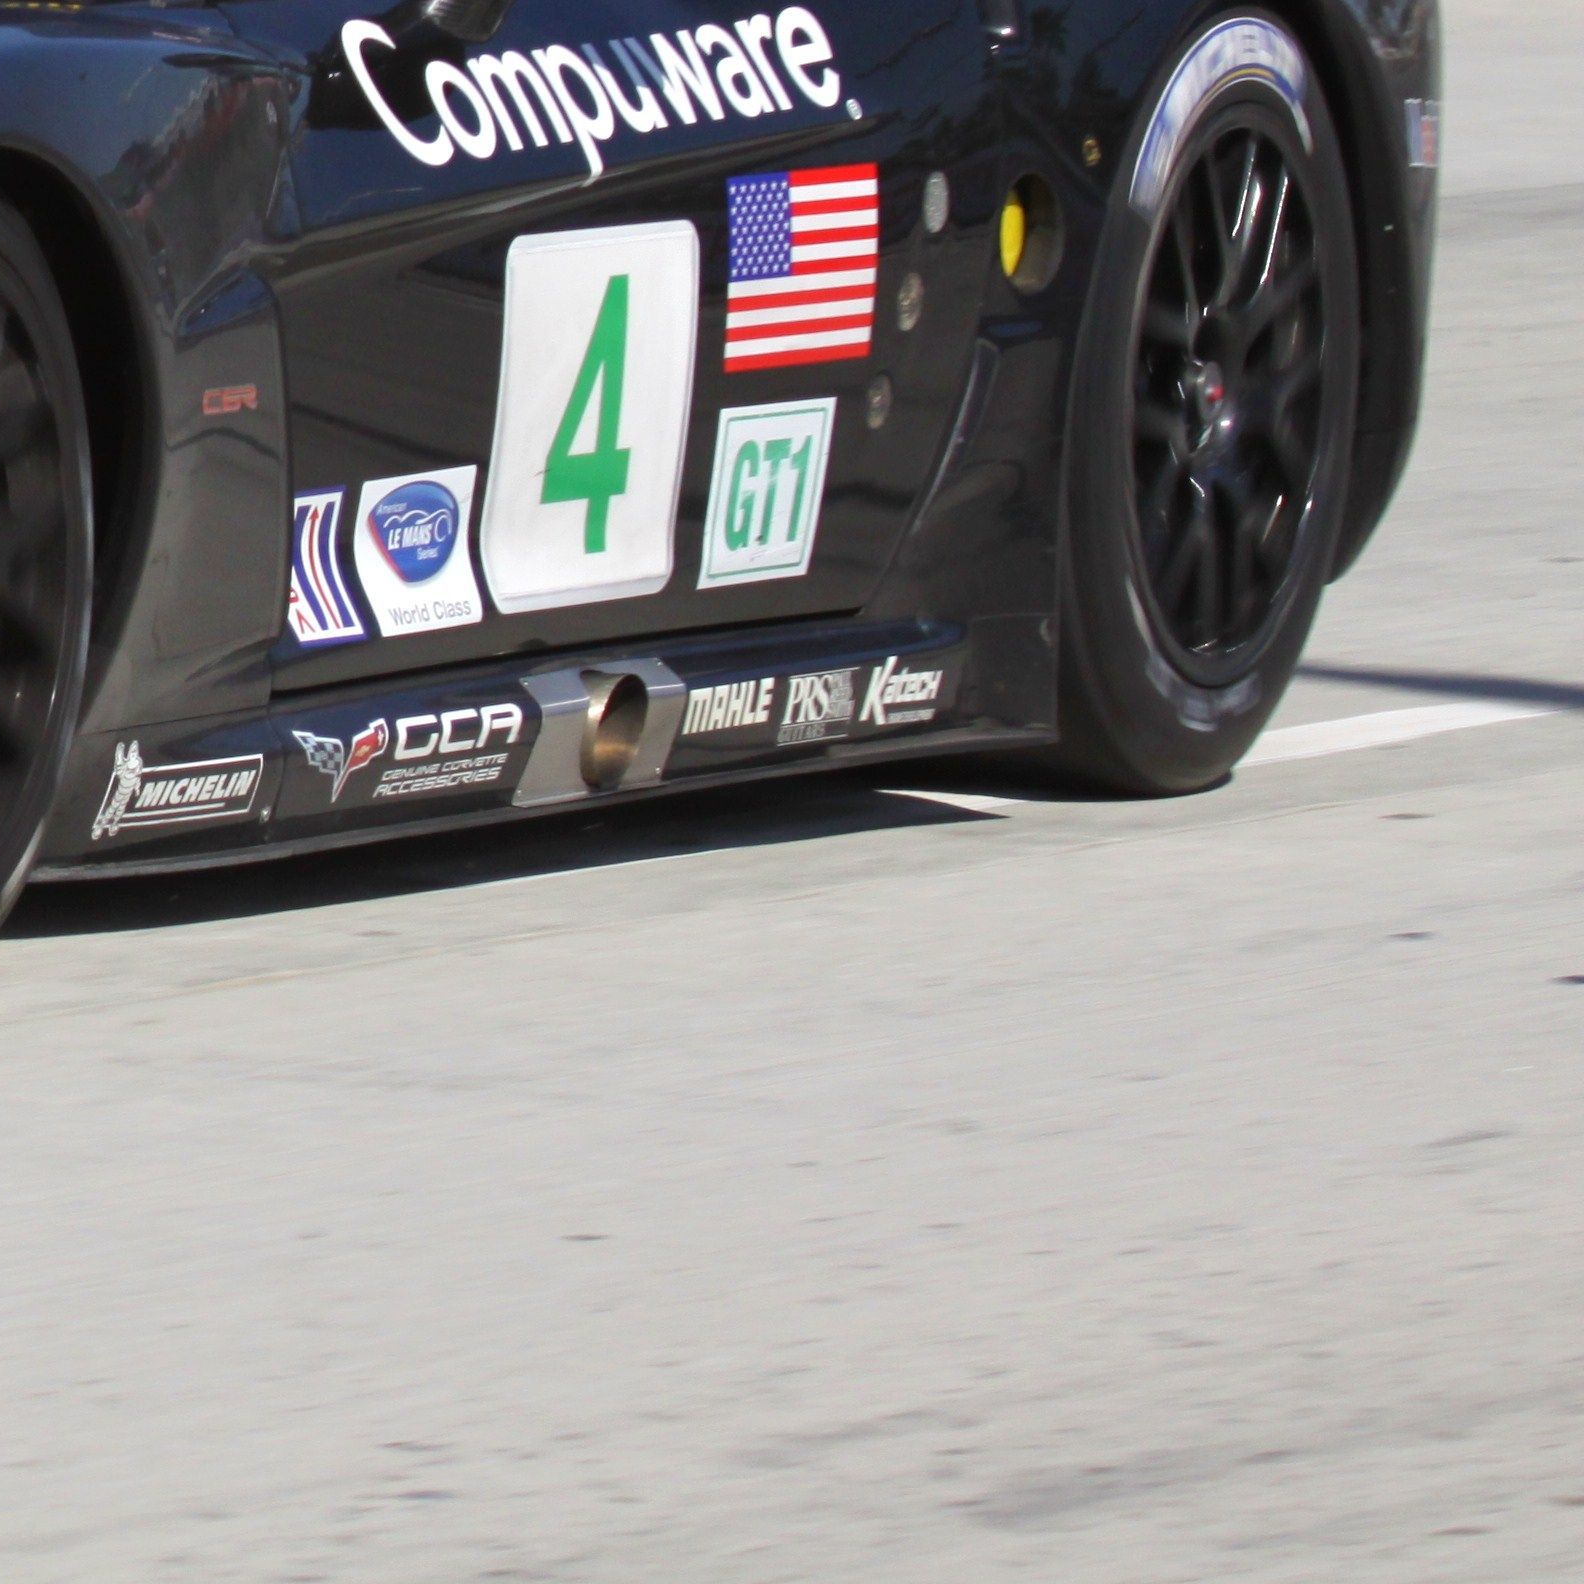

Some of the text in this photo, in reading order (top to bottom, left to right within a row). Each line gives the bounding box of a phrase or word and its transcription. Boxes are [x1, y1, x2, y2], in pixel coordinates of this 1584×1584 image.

[340, 5, 841, 188] Compuware
[539, 273, 632, 555] 4
[725, 435, 813, 552] GT1
[387, 523, 434, 551] LE MANS
[388, 598, 472, 628] World Class
[681, 676, 776, 736] MAHLE
[780, 673, 834, 726] PRS
[139, 768, 258, 809] MICHELIN
[372, 766, 503, 799] ACCESSORIES
[381, 752, 509, 784] GENUINE CORVETTE
